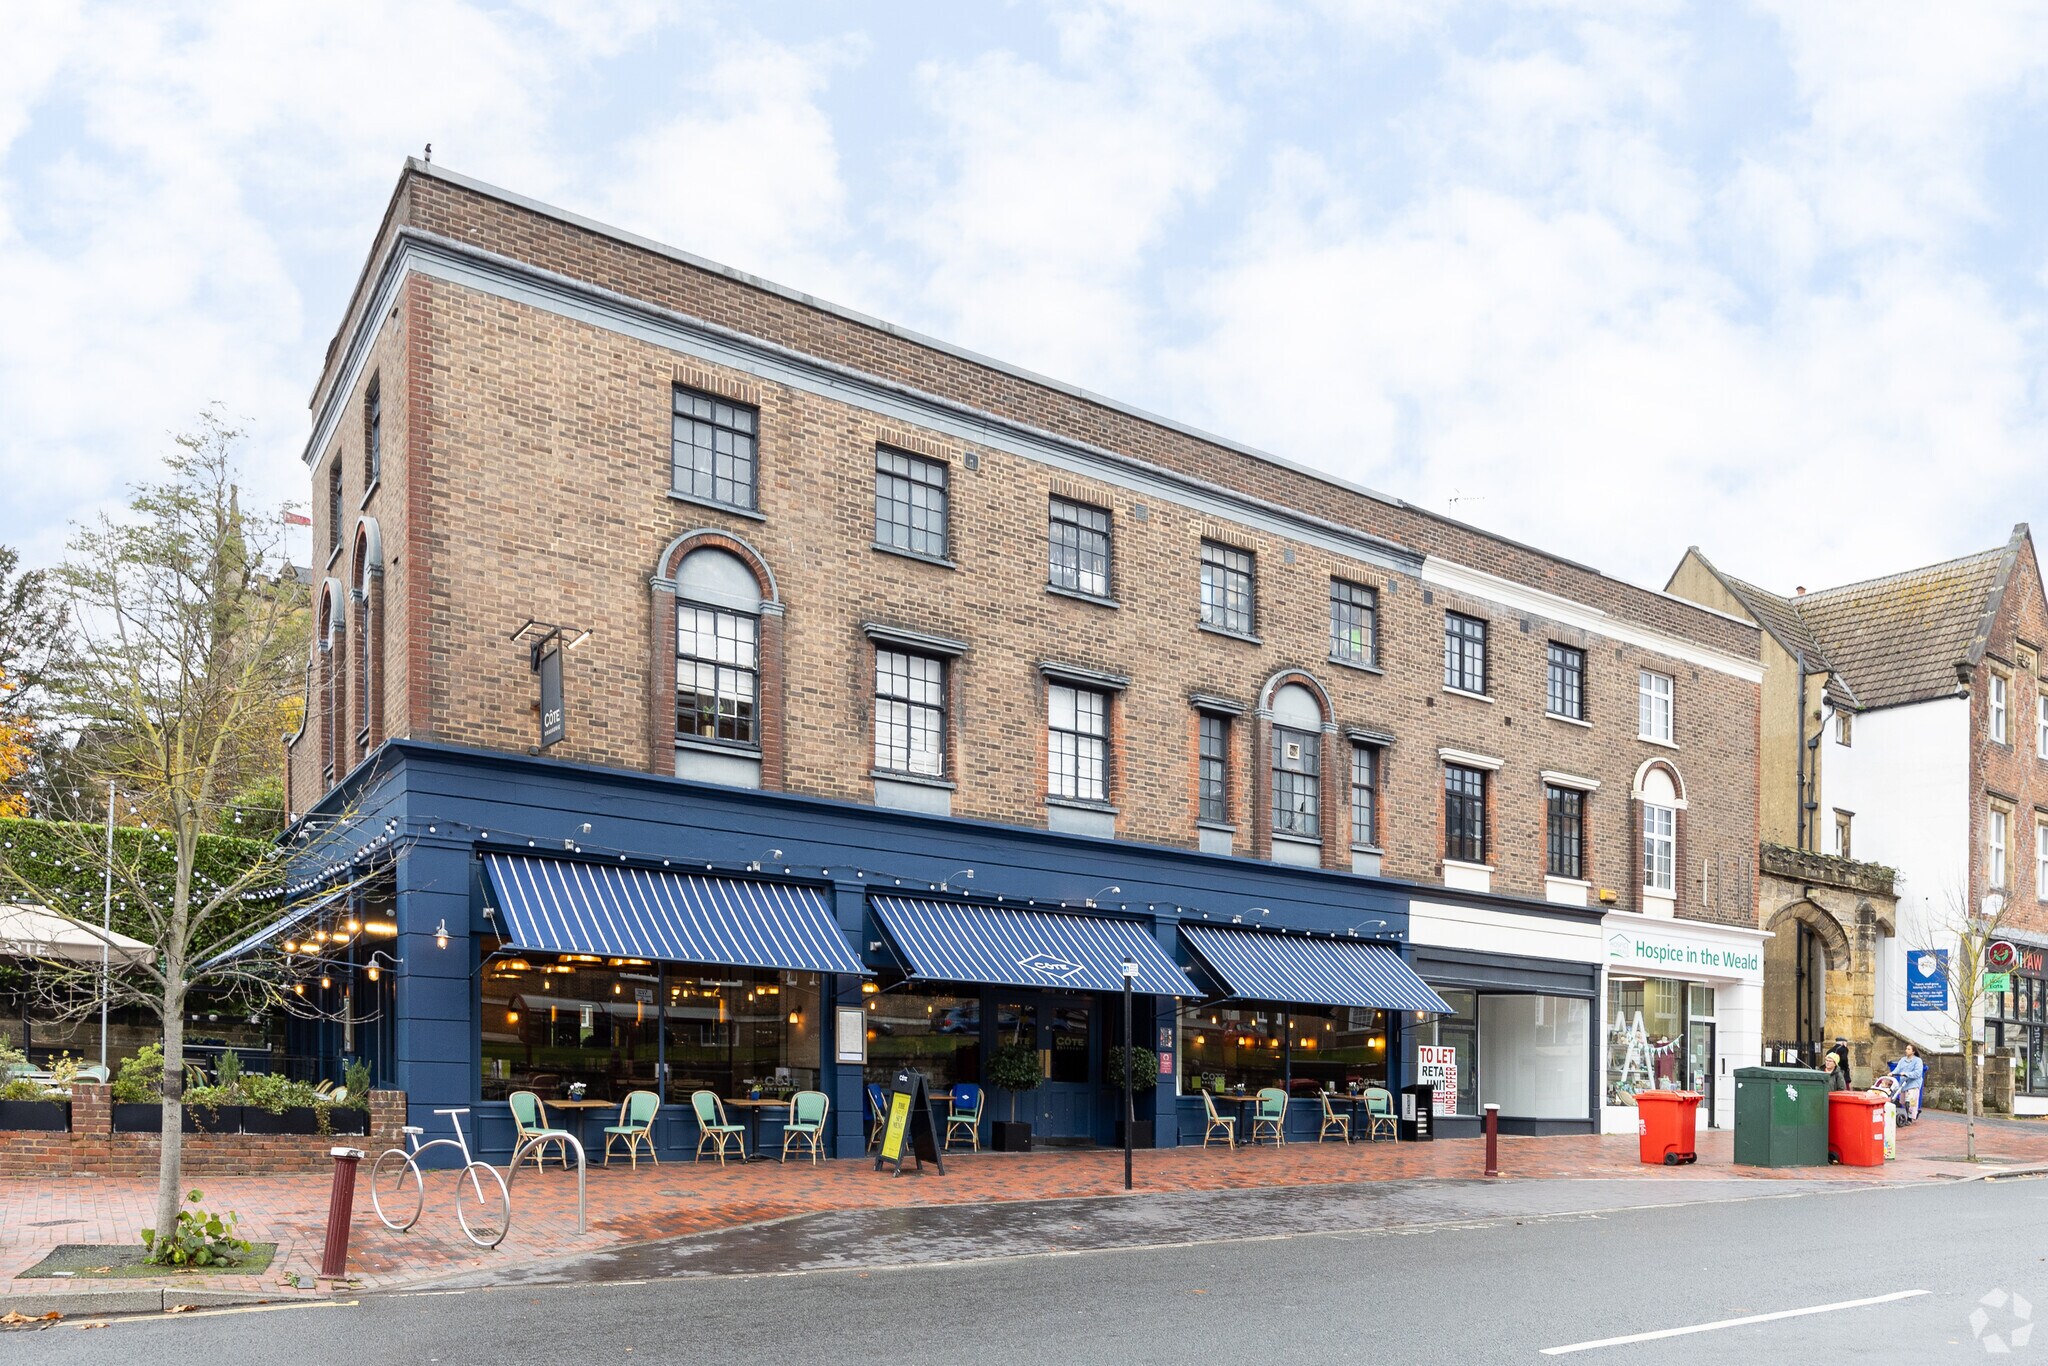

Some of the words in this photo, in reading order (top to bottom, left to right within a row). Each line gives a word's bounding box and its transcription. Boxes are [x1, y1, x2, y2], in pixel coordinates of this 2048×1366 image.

[544, 708, 561, 728] CÔTE
[1636, 940, 1683, 963] Hospice
[1686, 946, 1697, 963] in
[1701, 948, 1720, 966] the
[1723, 951, 1758, 971] Weald
[1420, 1048, 1433, 1063] TO
[1436, 1048, 1454, 1064] LET
[1422, 1066, 1444, 1077] RETA
[1445, 1066, 1457, 1089] OFFER
[1445, 1090, 1456, 1115] UNDER
